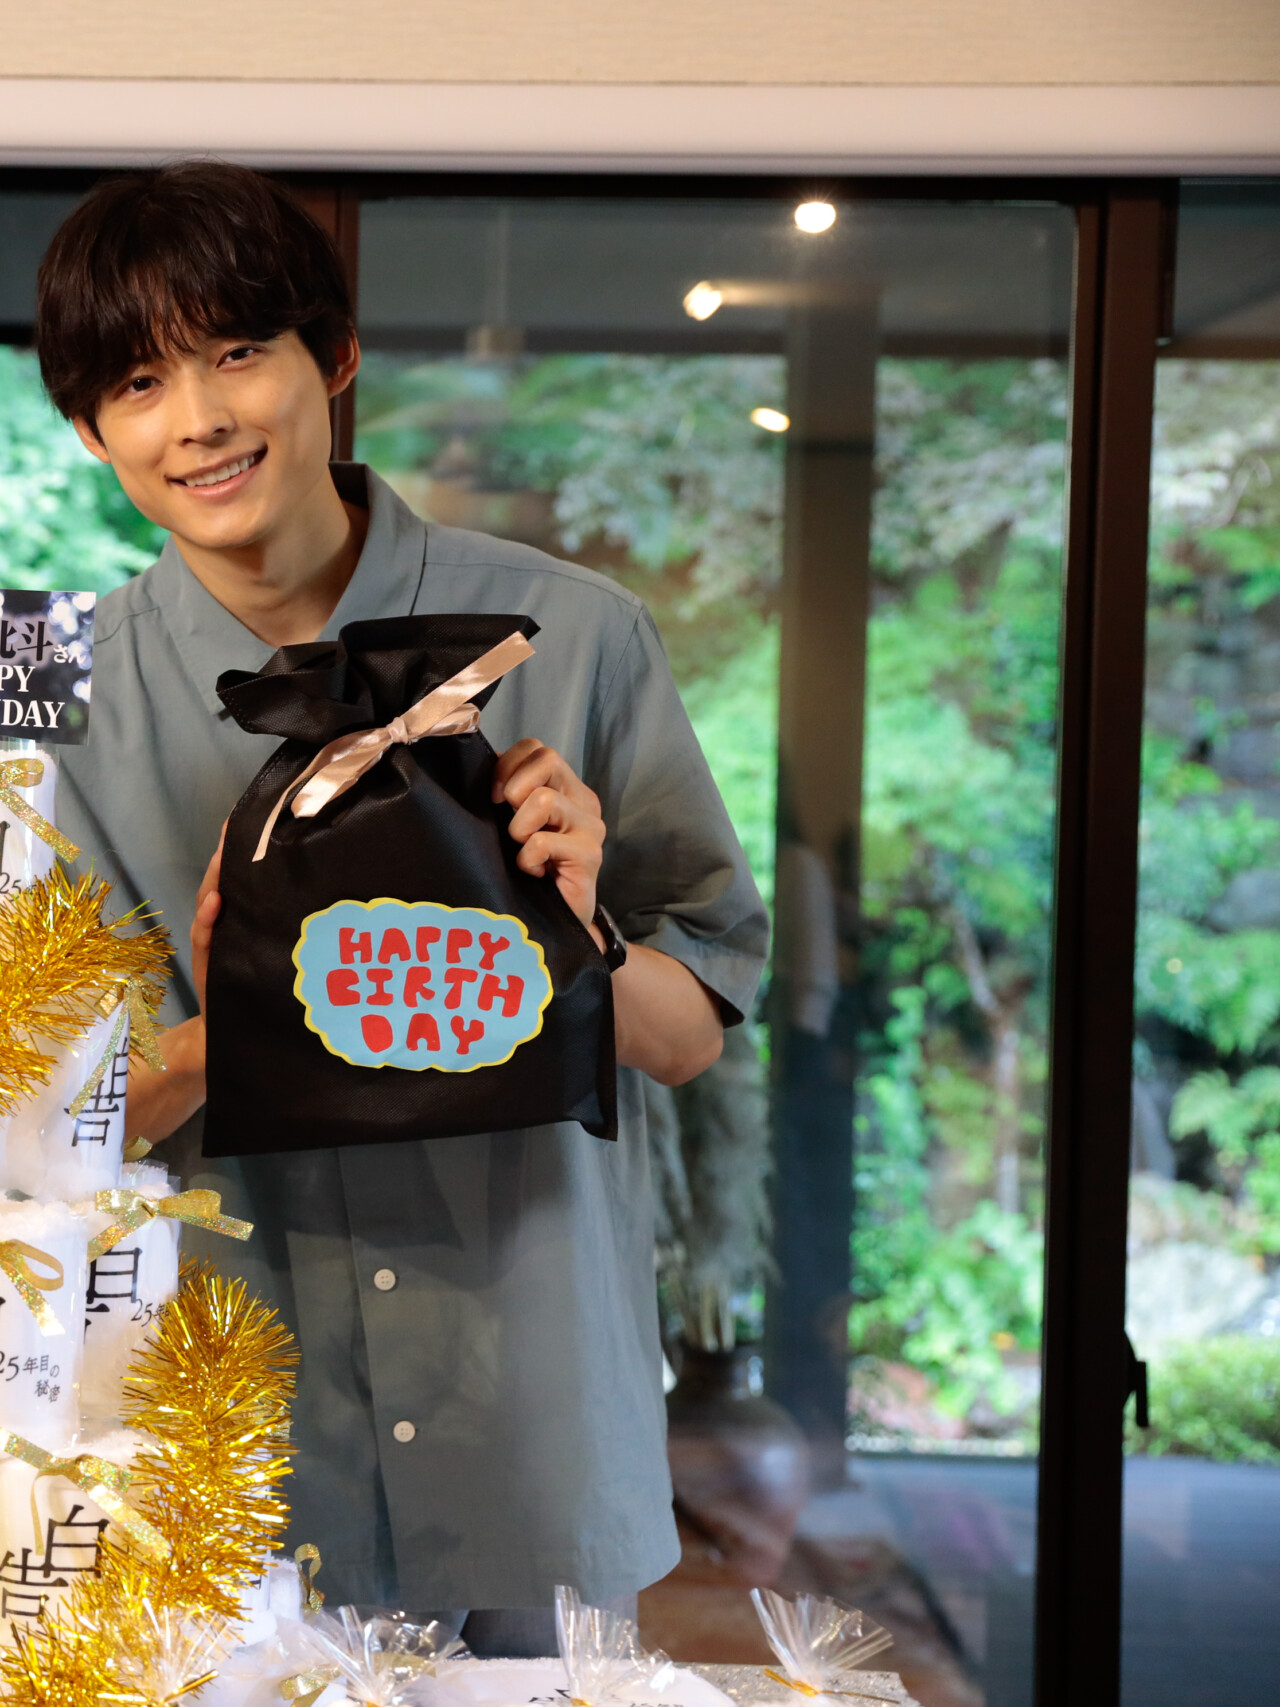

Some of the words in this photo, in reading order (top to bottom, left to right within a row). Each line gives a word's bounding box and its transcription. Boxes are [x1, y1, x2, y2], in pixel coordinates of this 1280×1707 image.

[338, 926, 510, 970] HAPPY
[326, 966, 525, 1018] BIRTH
[360, 1013, 485, 1055] DAY
